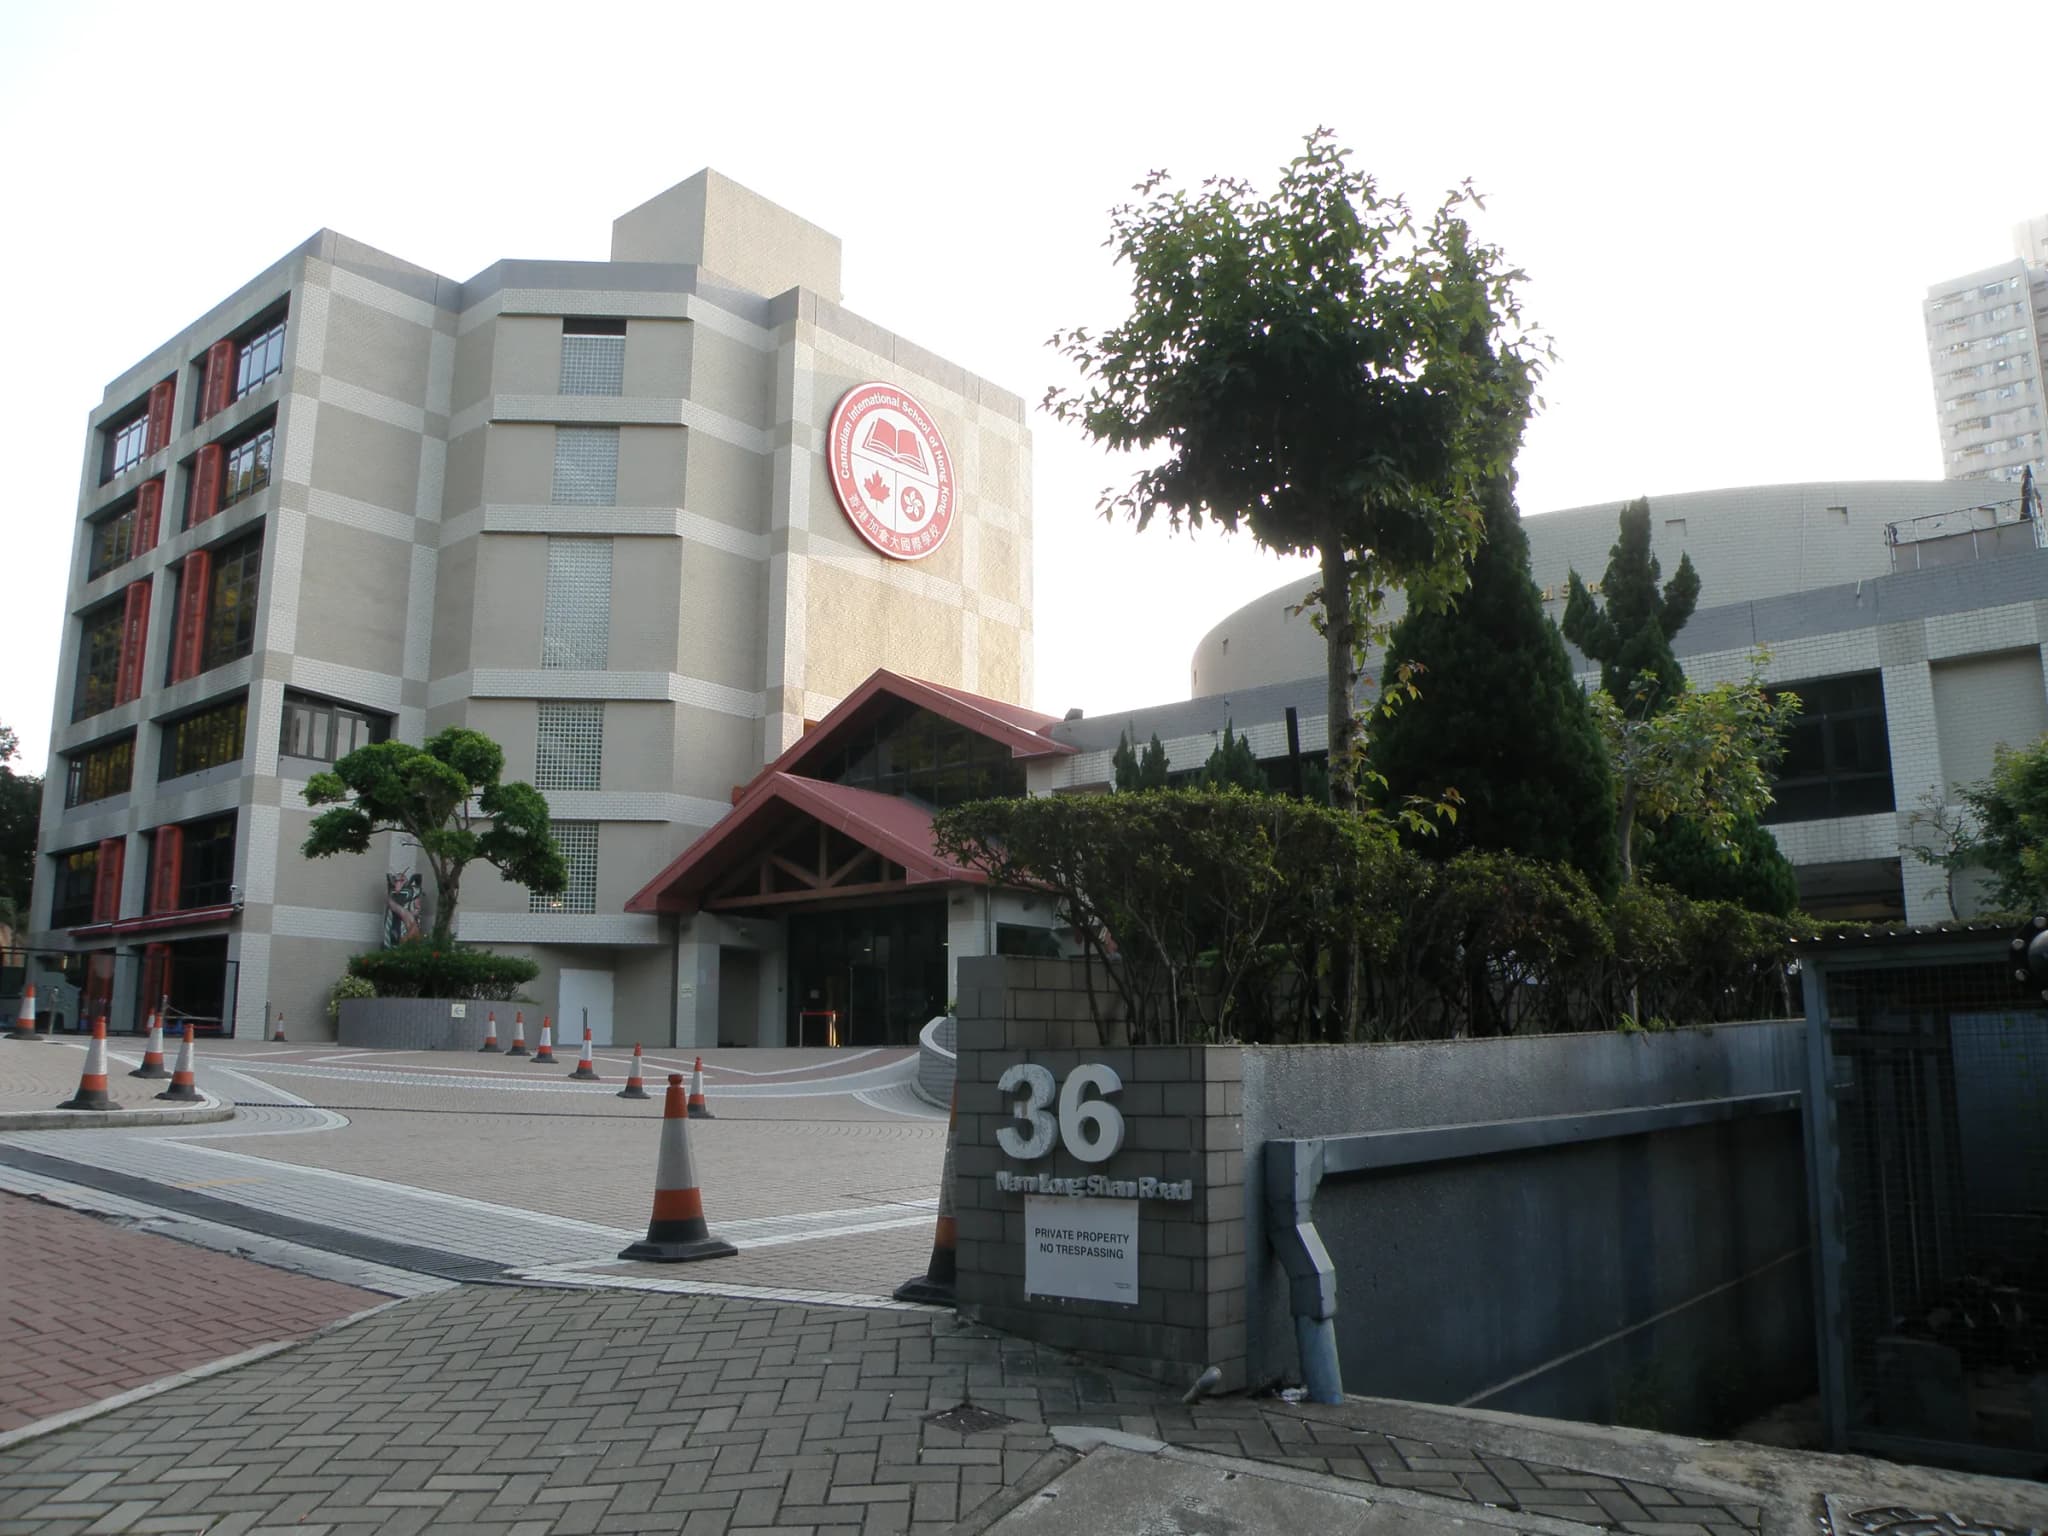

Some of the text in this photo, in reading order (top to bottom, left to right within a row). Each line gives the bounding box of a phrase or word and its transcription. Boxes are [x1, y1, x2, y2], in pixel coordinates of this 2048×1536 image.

[841, 392, 950, 516] Canadian International School of Hong Kong
[996, 1063, 1125, 1163] 36
[996, 1171, 1193, 1201] Nam Long Shan Road
[1034, 1228, 1130, 1243] PRIVATE PROPERTY
[1040, 1243, 1124, 1260] NO TRESPASSING
